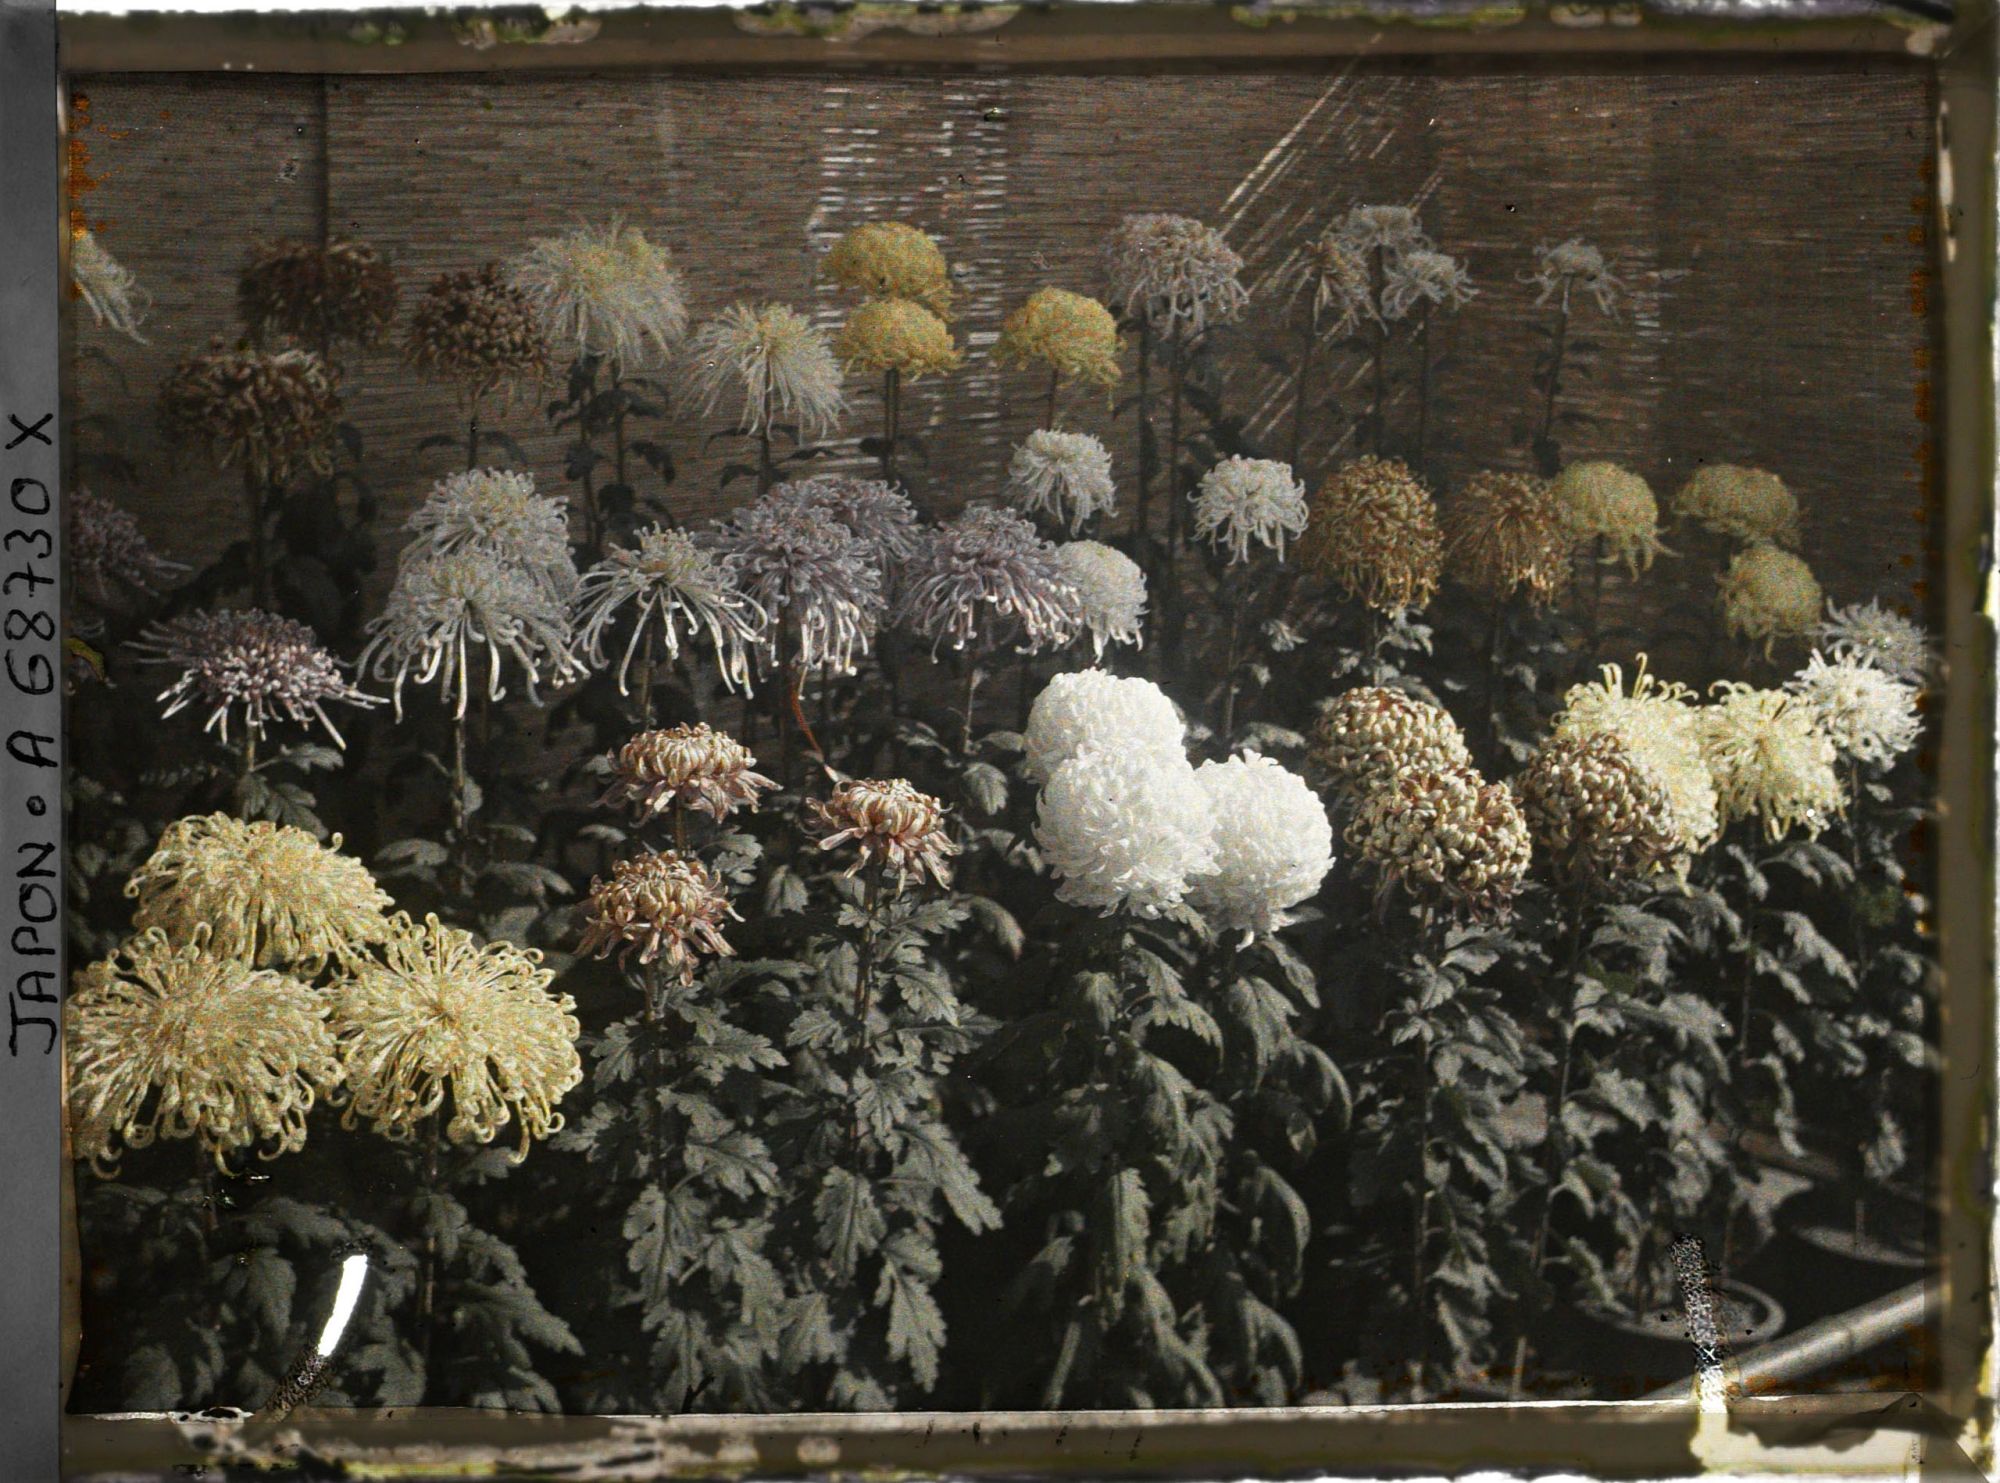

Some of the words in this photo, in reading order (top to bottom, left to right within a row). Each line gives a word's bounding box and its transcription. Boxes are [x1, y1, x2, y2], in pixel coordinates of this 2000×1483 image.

[5, 413, 53, 450] X
[3, 478, 55, 696] 68730
[6, 730, 58, 768] A
[9, 842, 57, 1057] JAPON
